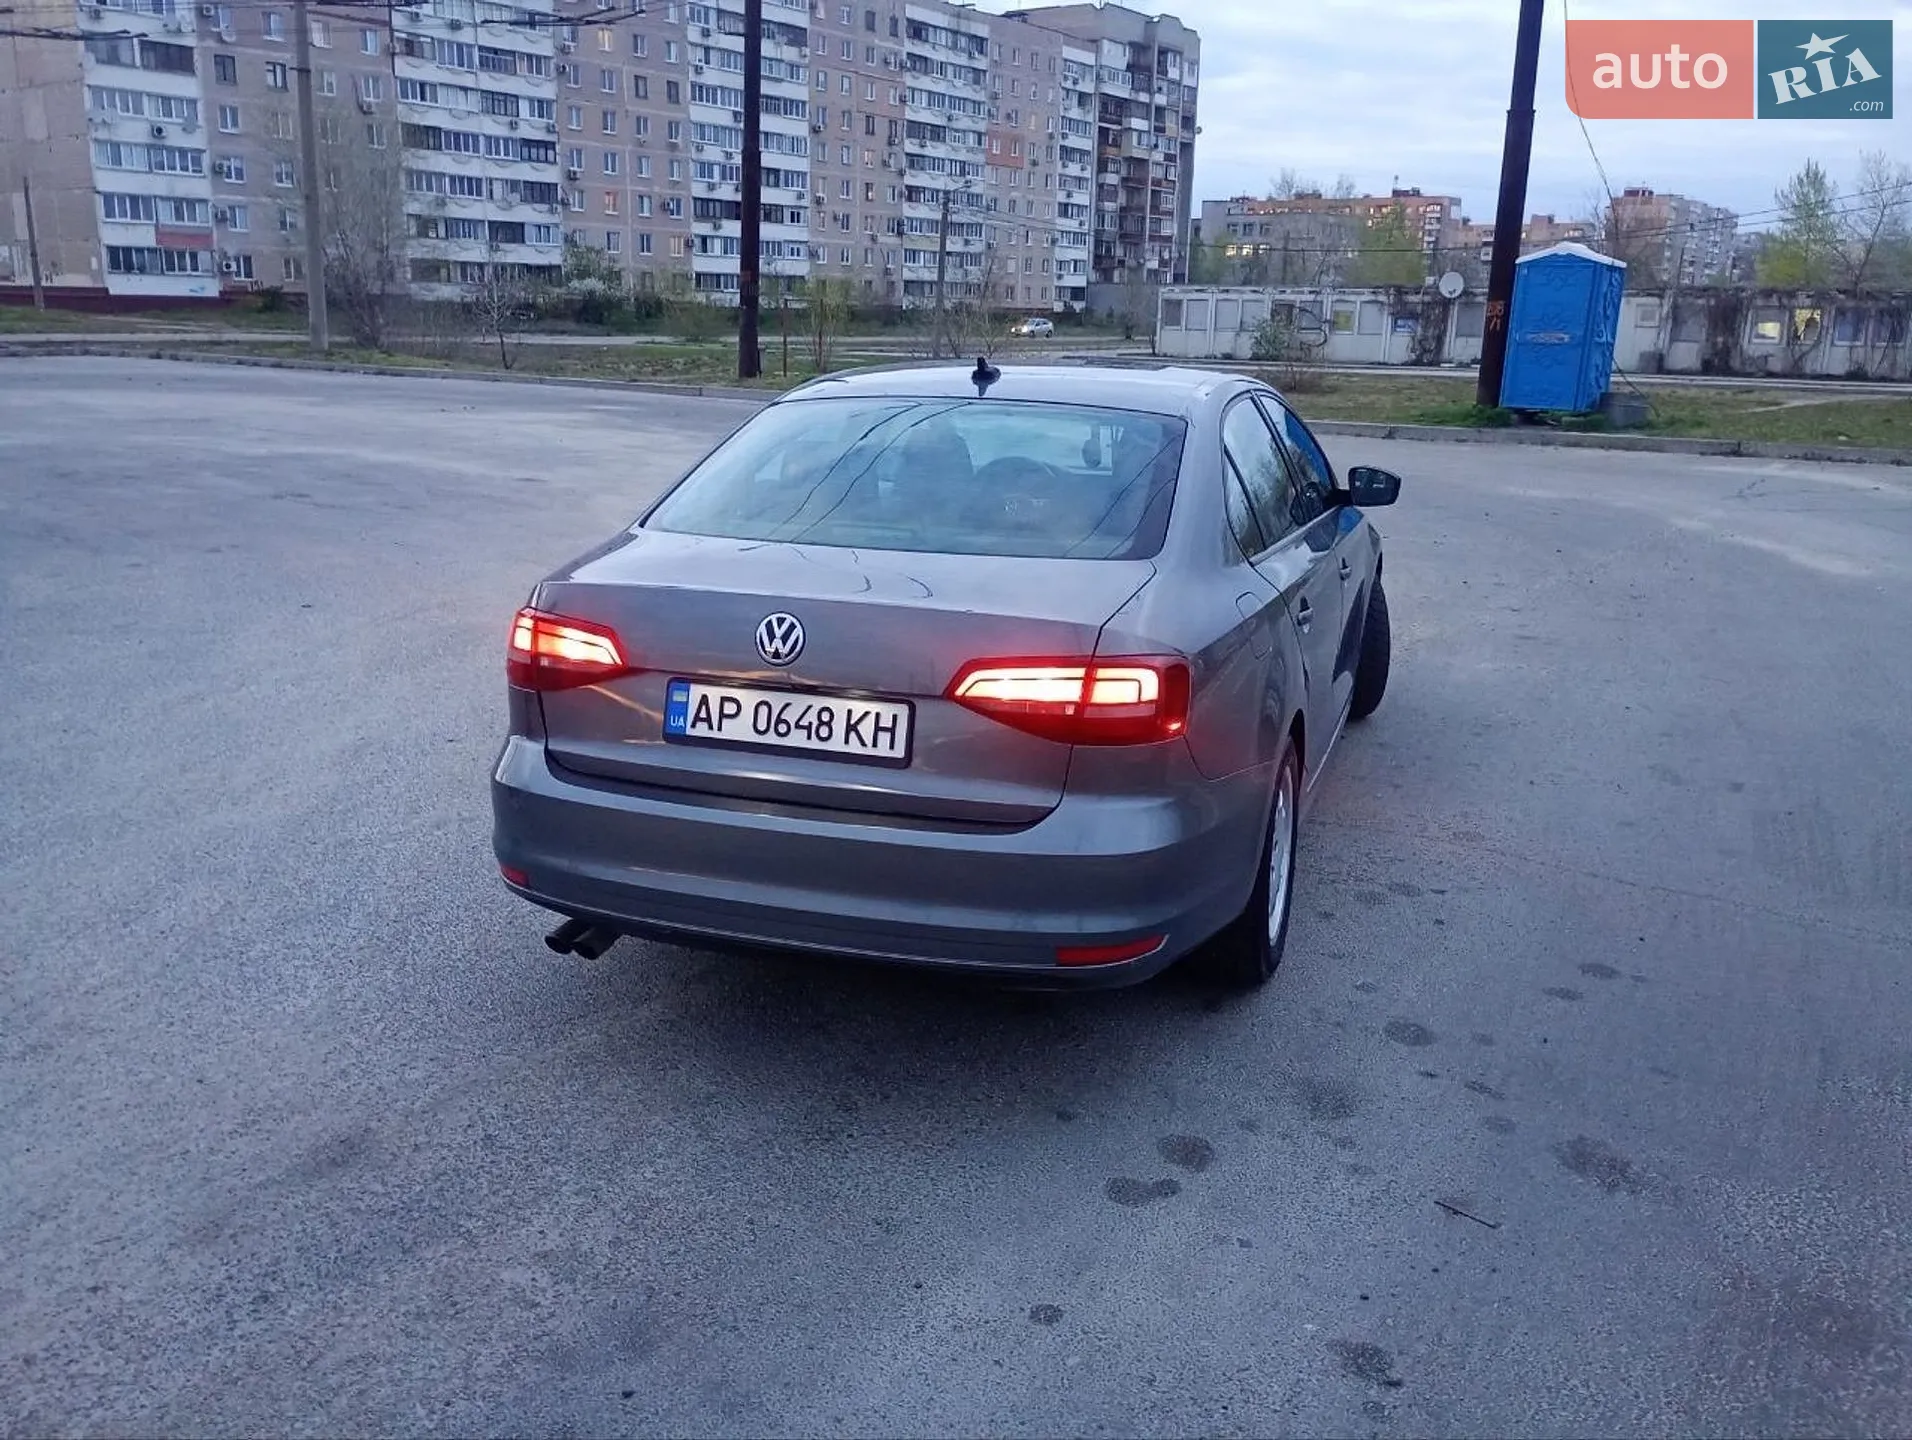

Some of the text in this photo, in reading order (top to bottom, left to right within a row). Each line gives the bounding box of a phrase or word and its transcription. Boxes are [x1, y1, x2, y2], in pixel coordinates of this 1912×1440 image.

[670, 716, 685, 728] UA
[690, 694, 898, 750] AP 0648 KH
